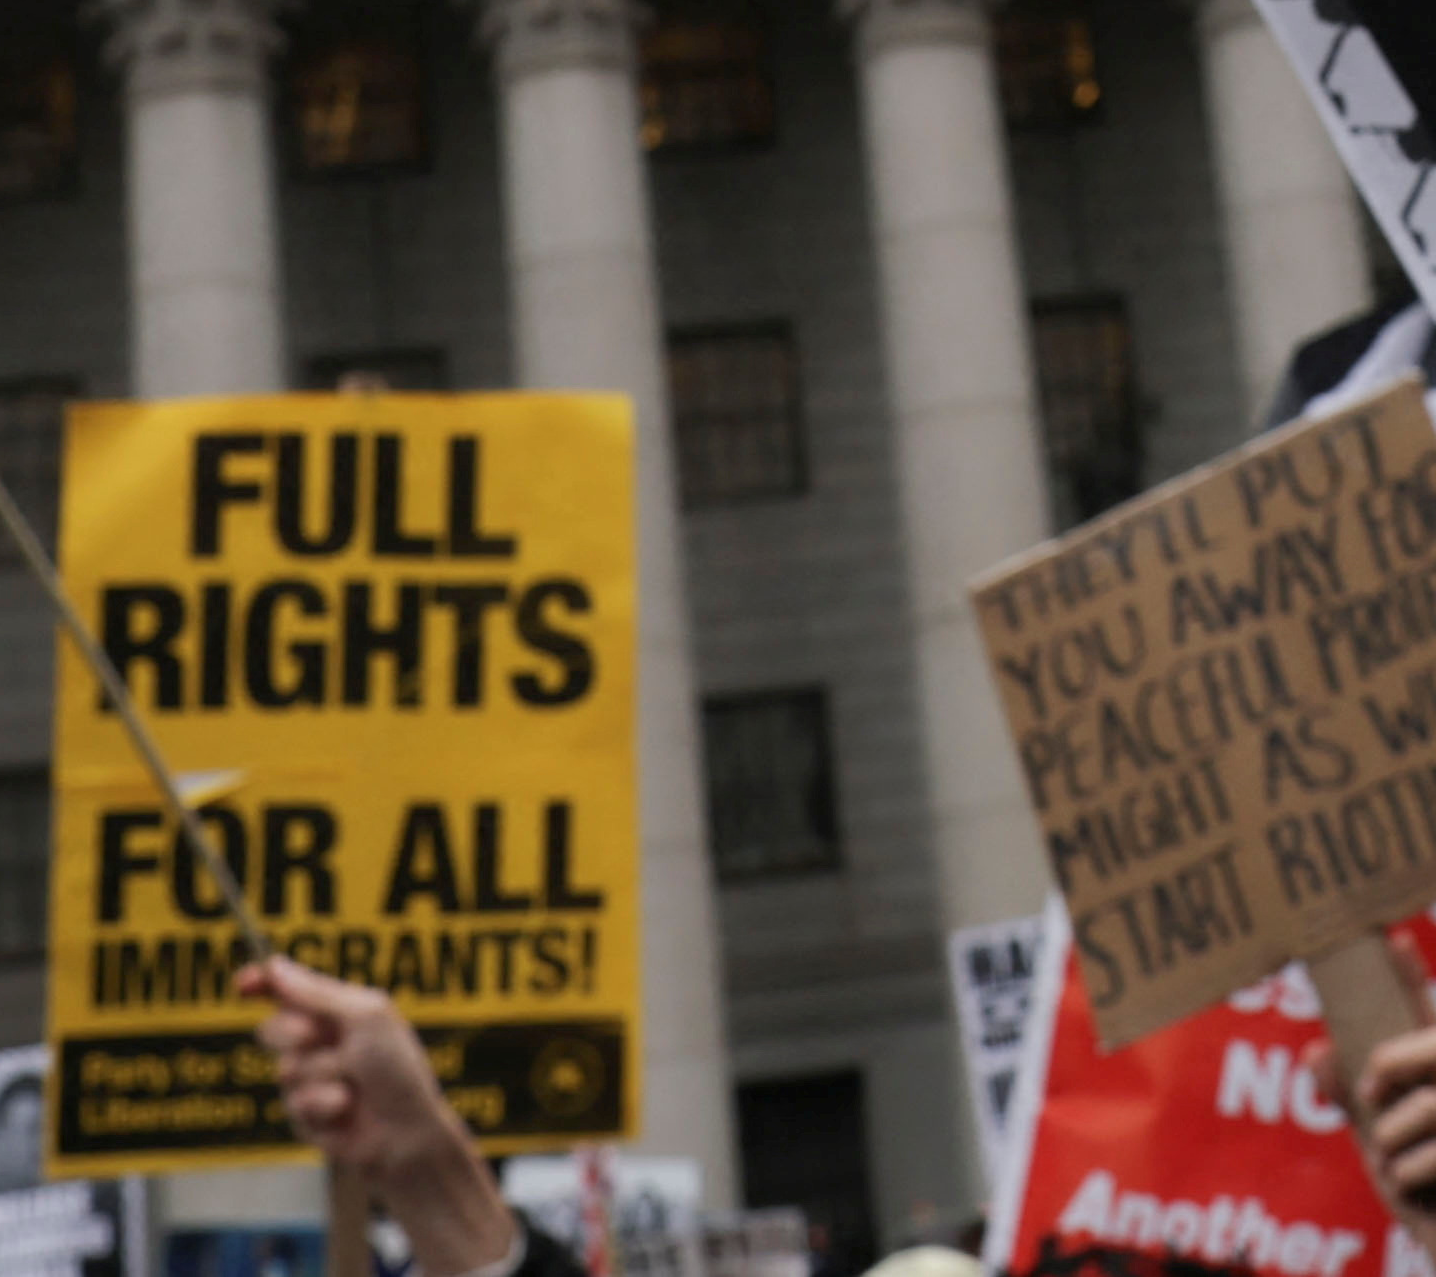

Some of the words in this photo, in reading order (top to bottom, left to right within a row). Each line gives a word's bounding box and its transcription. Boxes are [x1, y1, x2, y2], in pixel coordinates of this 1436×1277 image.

[189, 432, 519, 560] FULL
[1232, 407, 1388, 527] PUT
[99, 577, 596, 714] RIGHTS
[999, 604, 1147, 719] YOU
[1169, 514, 1346, 645] AWAY
[1021, 637, 1295, 811] PEACEFUL
[96, 800, 339, 923] FOR
[384, 799, 604, 913] ALL
[1046, 754, 1234, 894] MIGHT
[1264, 712, 1360, 801] AS
[92, 929, 596, 1009] IMMGRANTS!
[1076, 847, 1254, 1010] START
[1057, 1167, 1364, 1277] Another
